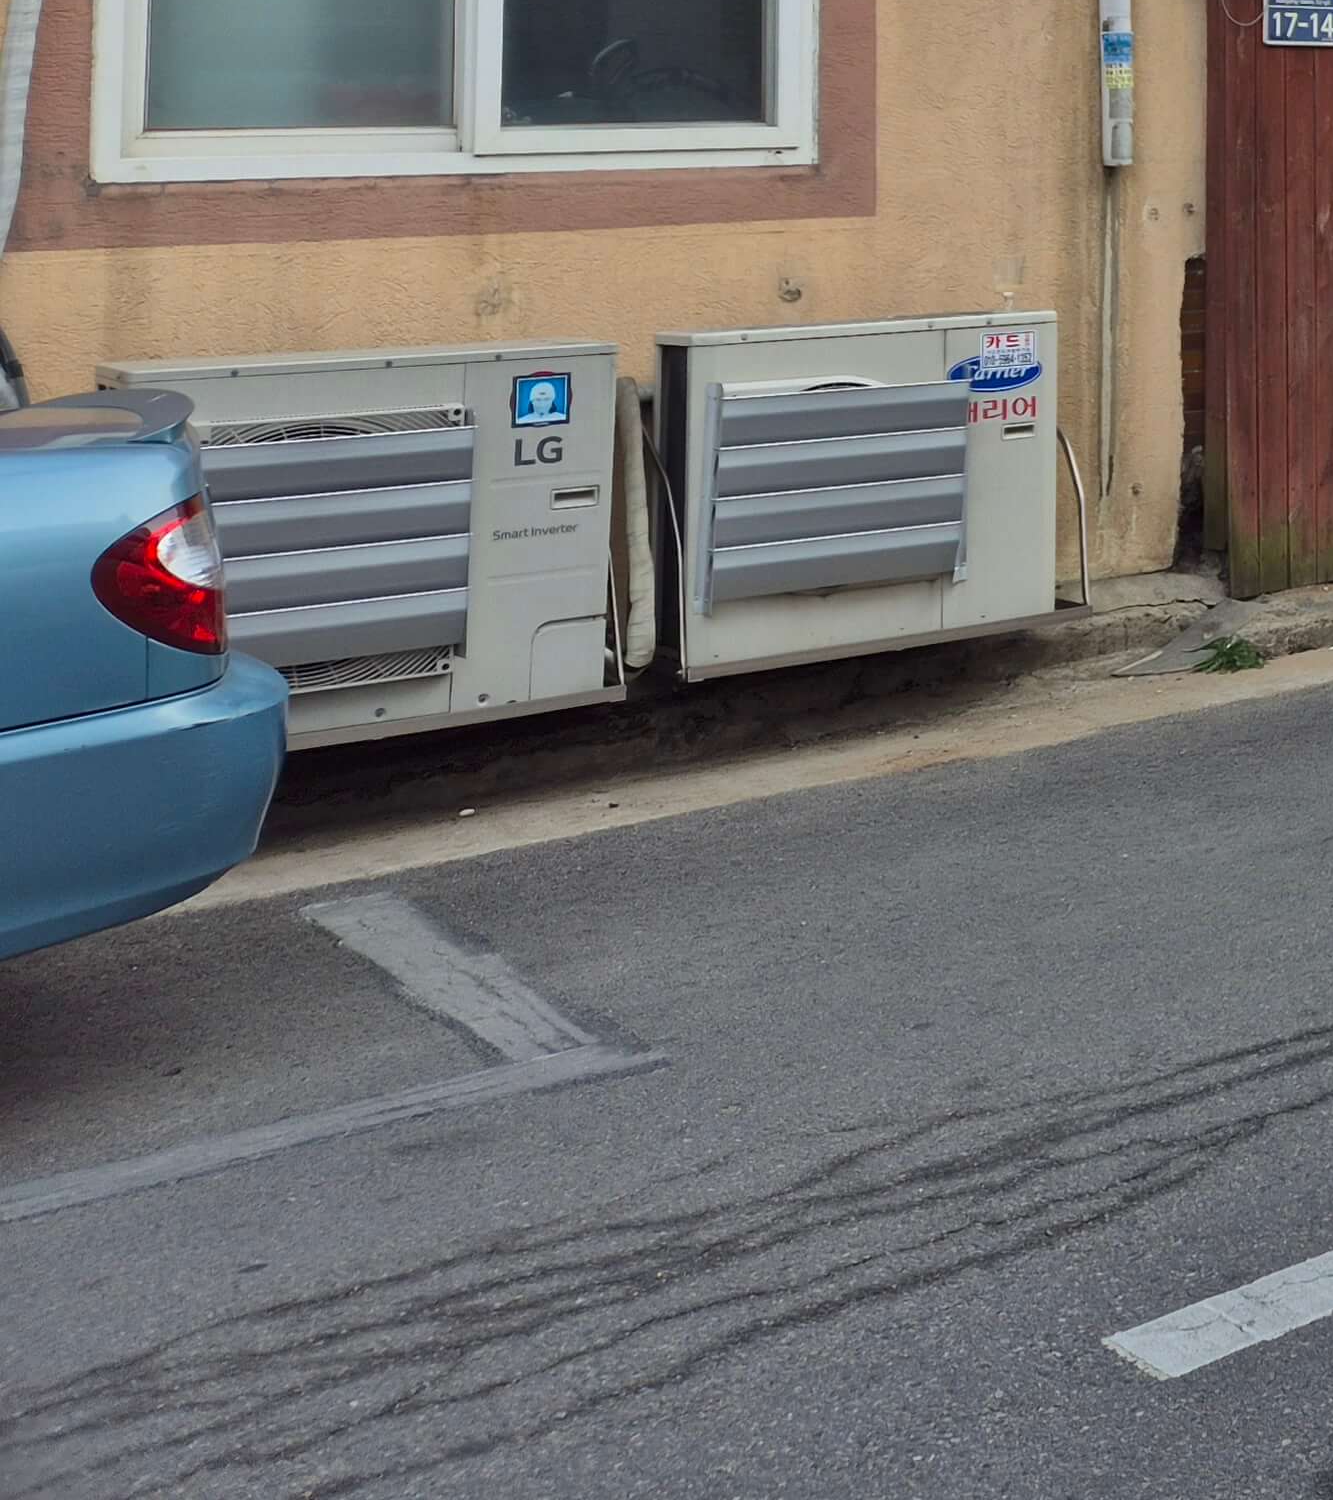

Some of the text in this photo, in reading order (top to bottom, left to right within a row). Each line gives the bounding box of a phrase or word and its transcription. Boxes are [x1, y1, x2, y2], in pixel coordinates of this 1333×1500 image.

[986, 334, 1021, 348] 카드
[514, 436, 563, 466] LG
[493, 523, 580, 541] Smart Inverter
